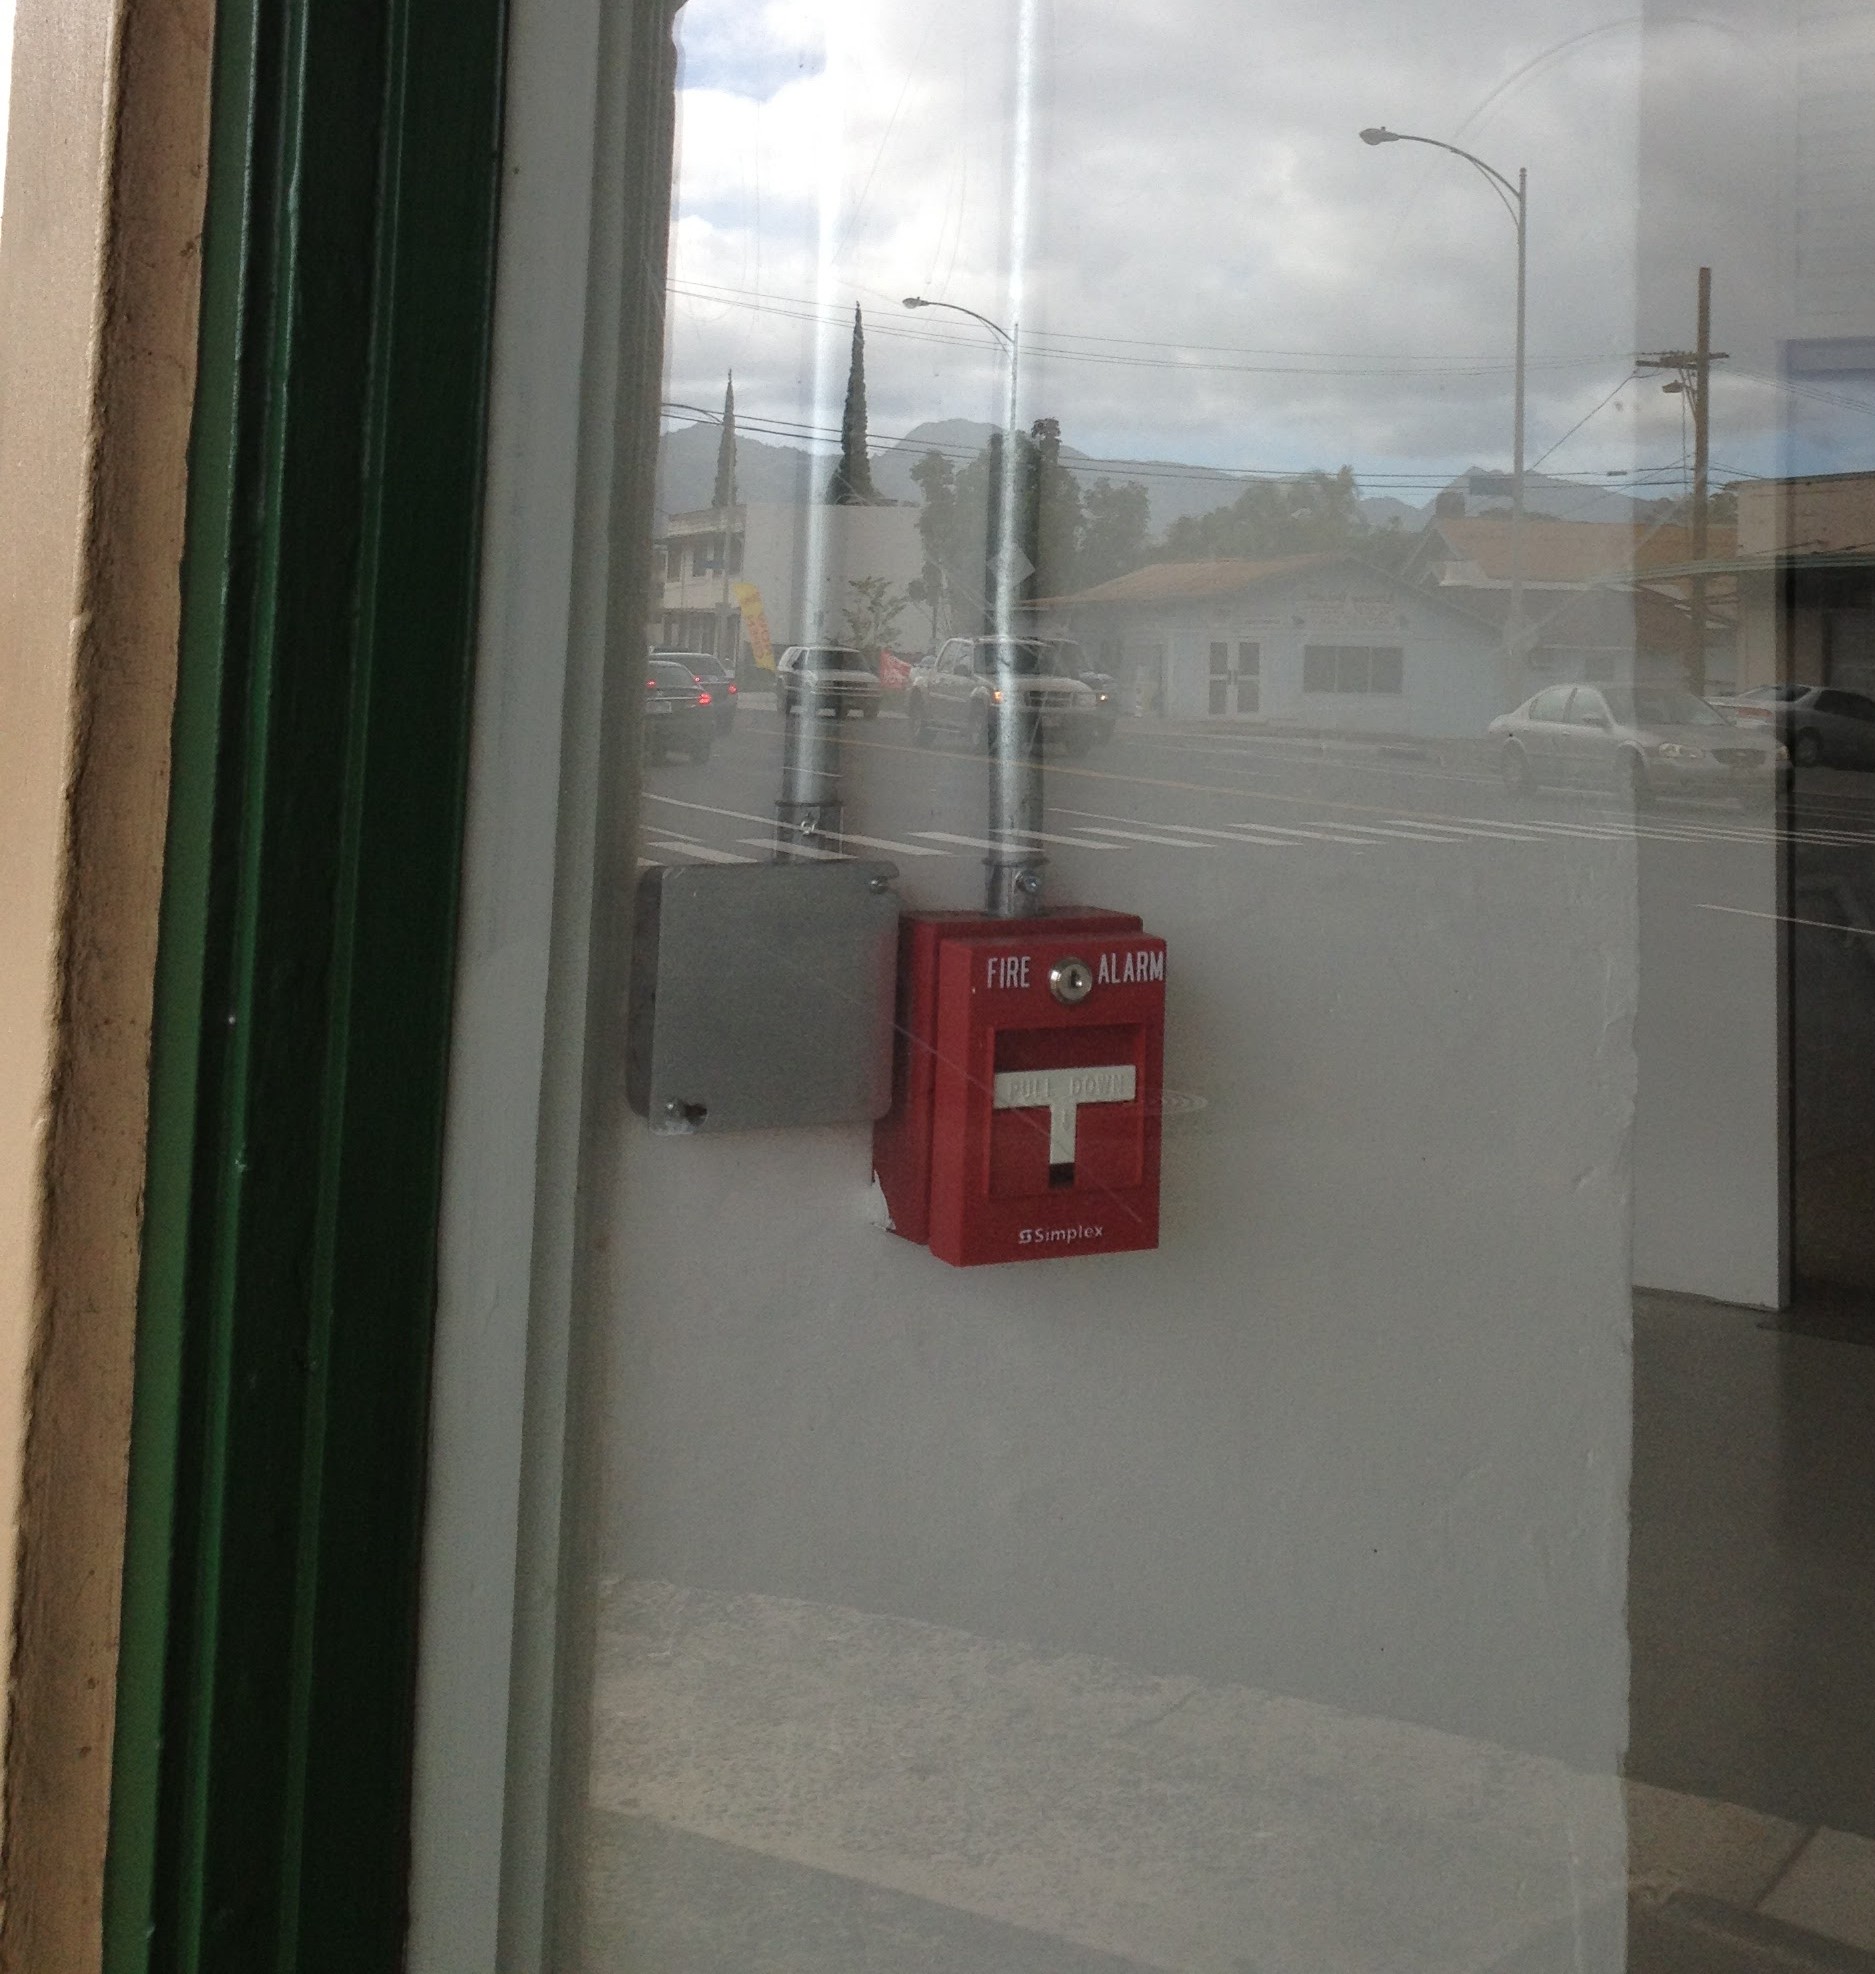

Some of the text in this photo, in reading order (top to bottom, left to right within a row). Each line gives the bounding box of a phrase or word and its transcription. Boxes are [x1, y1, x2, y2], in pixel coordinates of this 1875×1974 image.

[987, 951, 1164, 989] FIRE ALARM
[1007, 1074, 1125, 1100] PULL DOWN
[1034, 1224, 1103, 1244] Simplex
